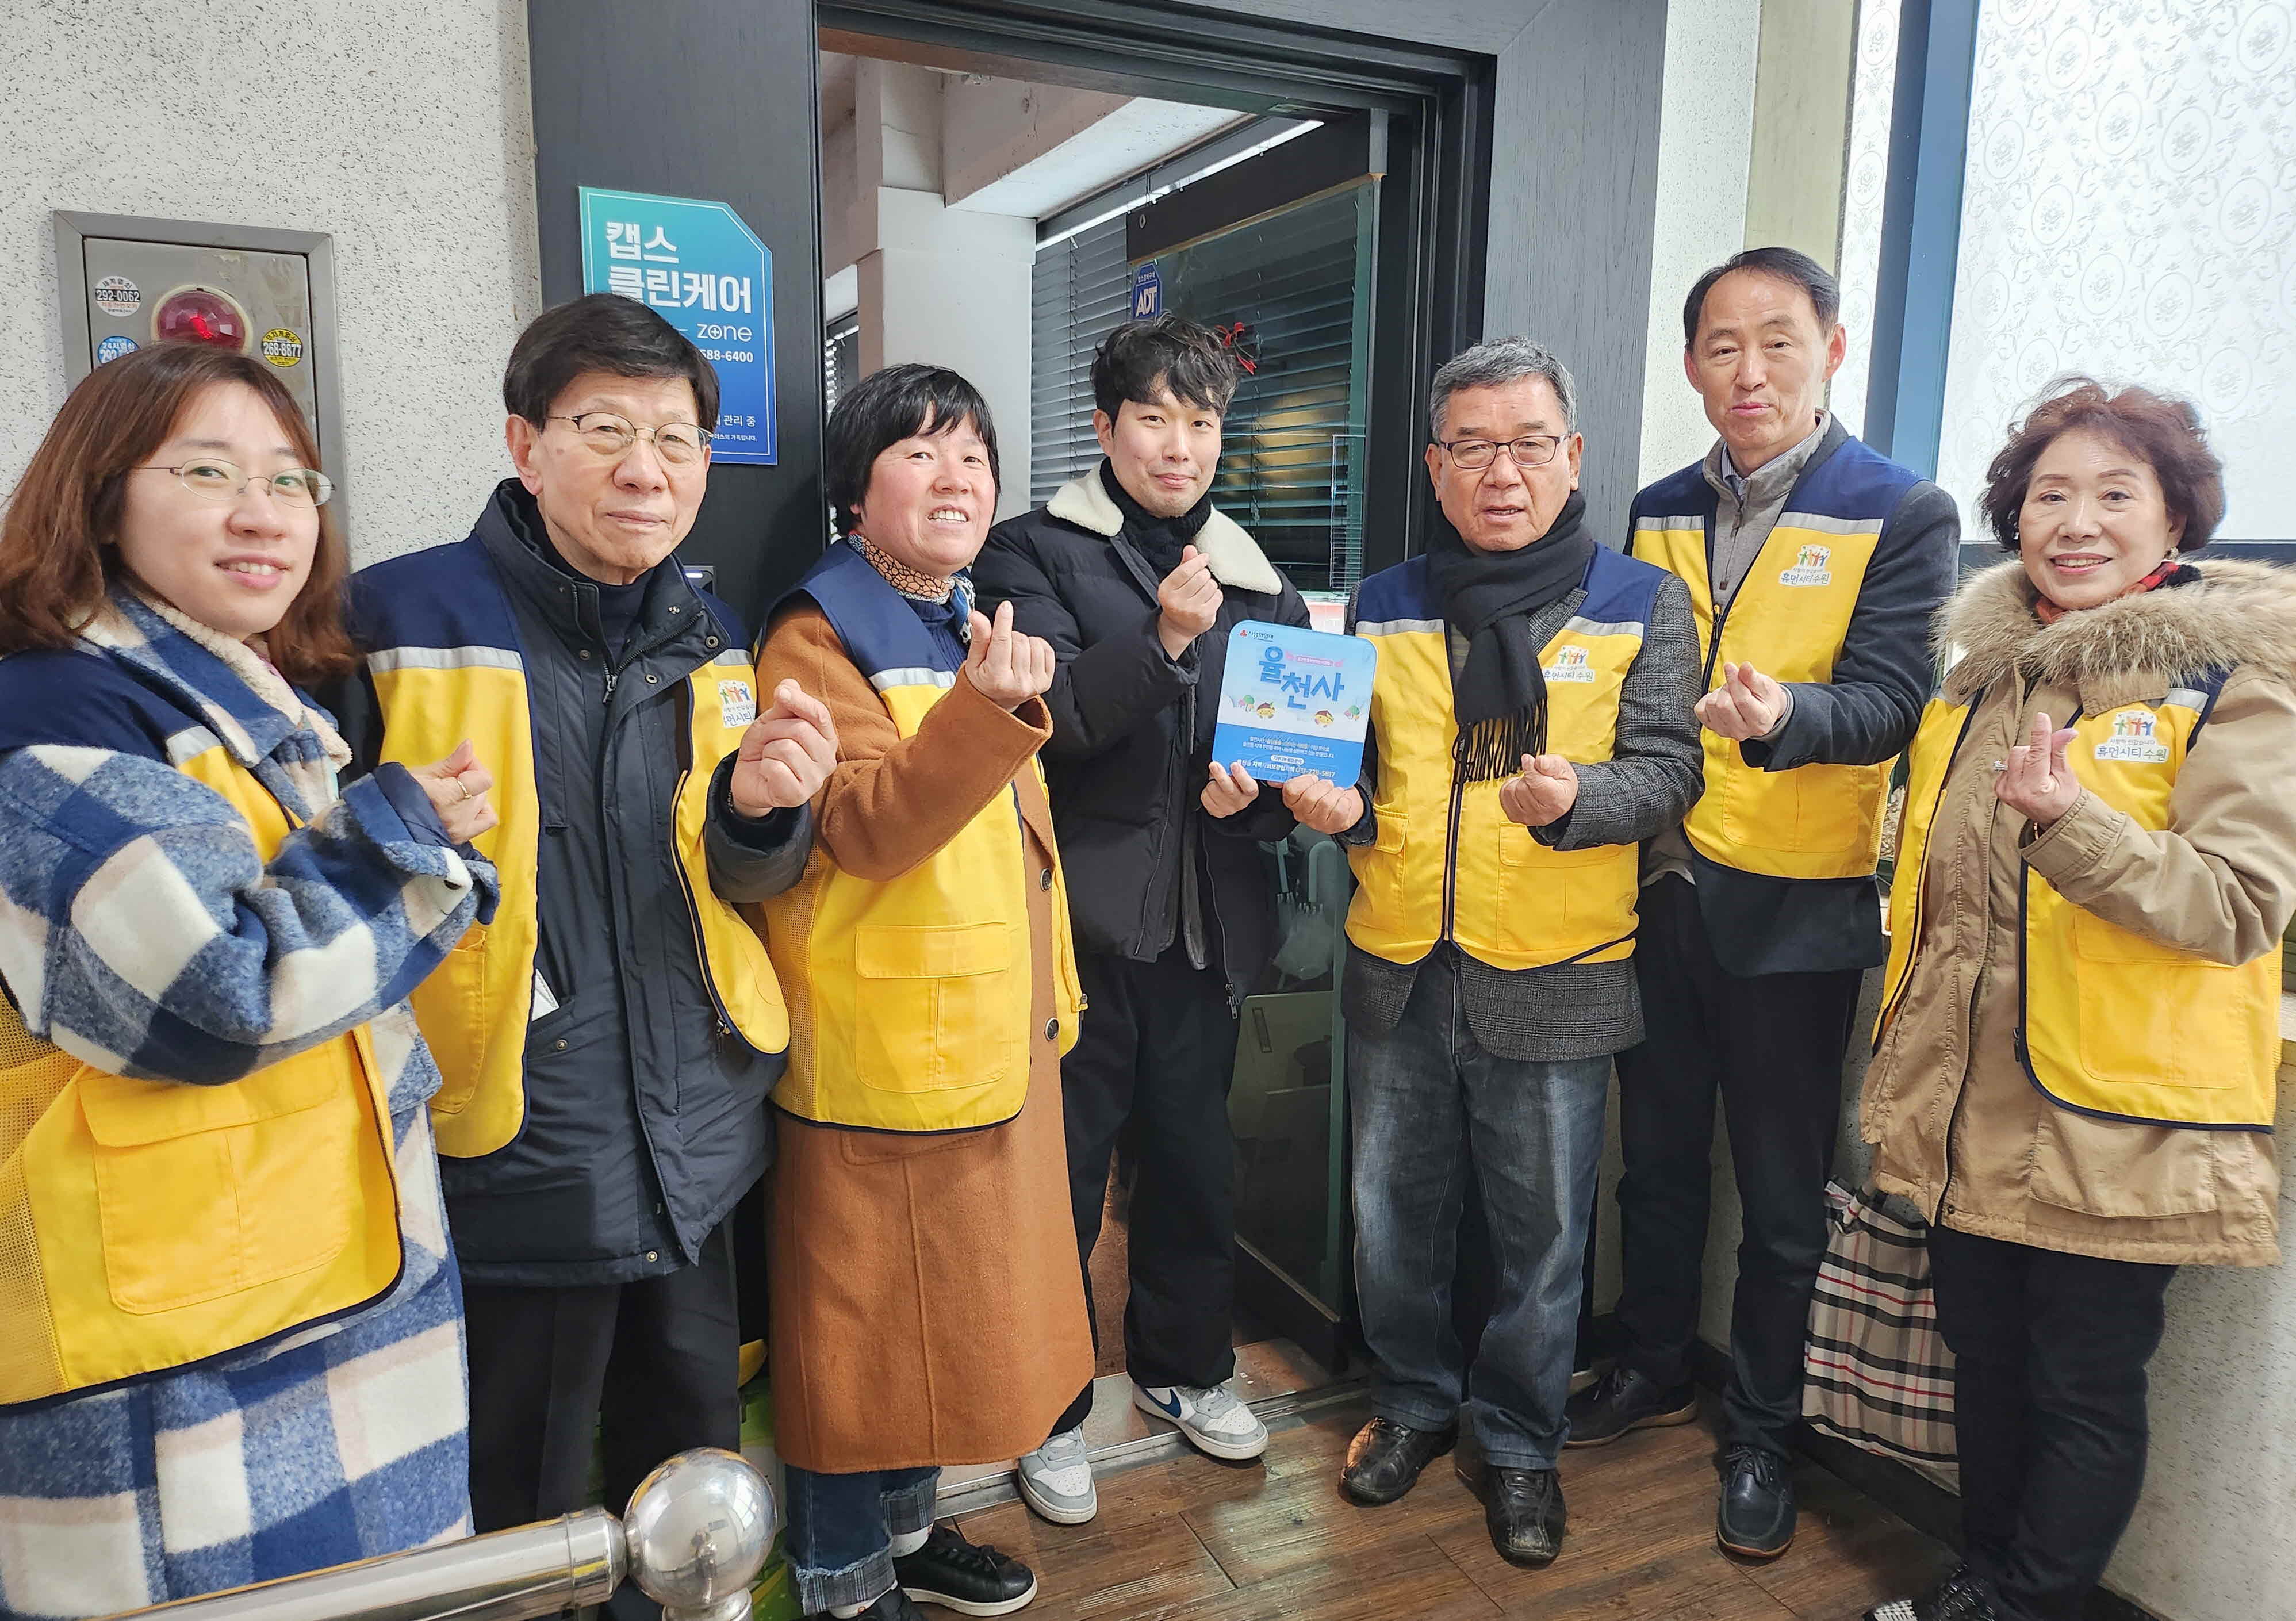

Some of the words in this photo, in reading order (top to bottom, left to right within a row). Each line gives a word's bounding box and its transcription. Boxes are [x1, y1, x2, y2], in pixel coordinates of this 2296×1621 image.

[605, 221, 679, 264] 캡스
[96, 289, 140, 302] 292-0062
[608, 266, 752, 314] 클린케어
[1136, 286, 1157, 317] ADT
[263, 342, 302, 357] 268-8877
[723, 414, 743, 427] 관리
[746, 415, 756, 427] 중
[1258, 646, 1345, 710] 율천사
[2096, 745, 2142, 759] 휴먼시티
[2143, 748, 2168, 762] 수원
